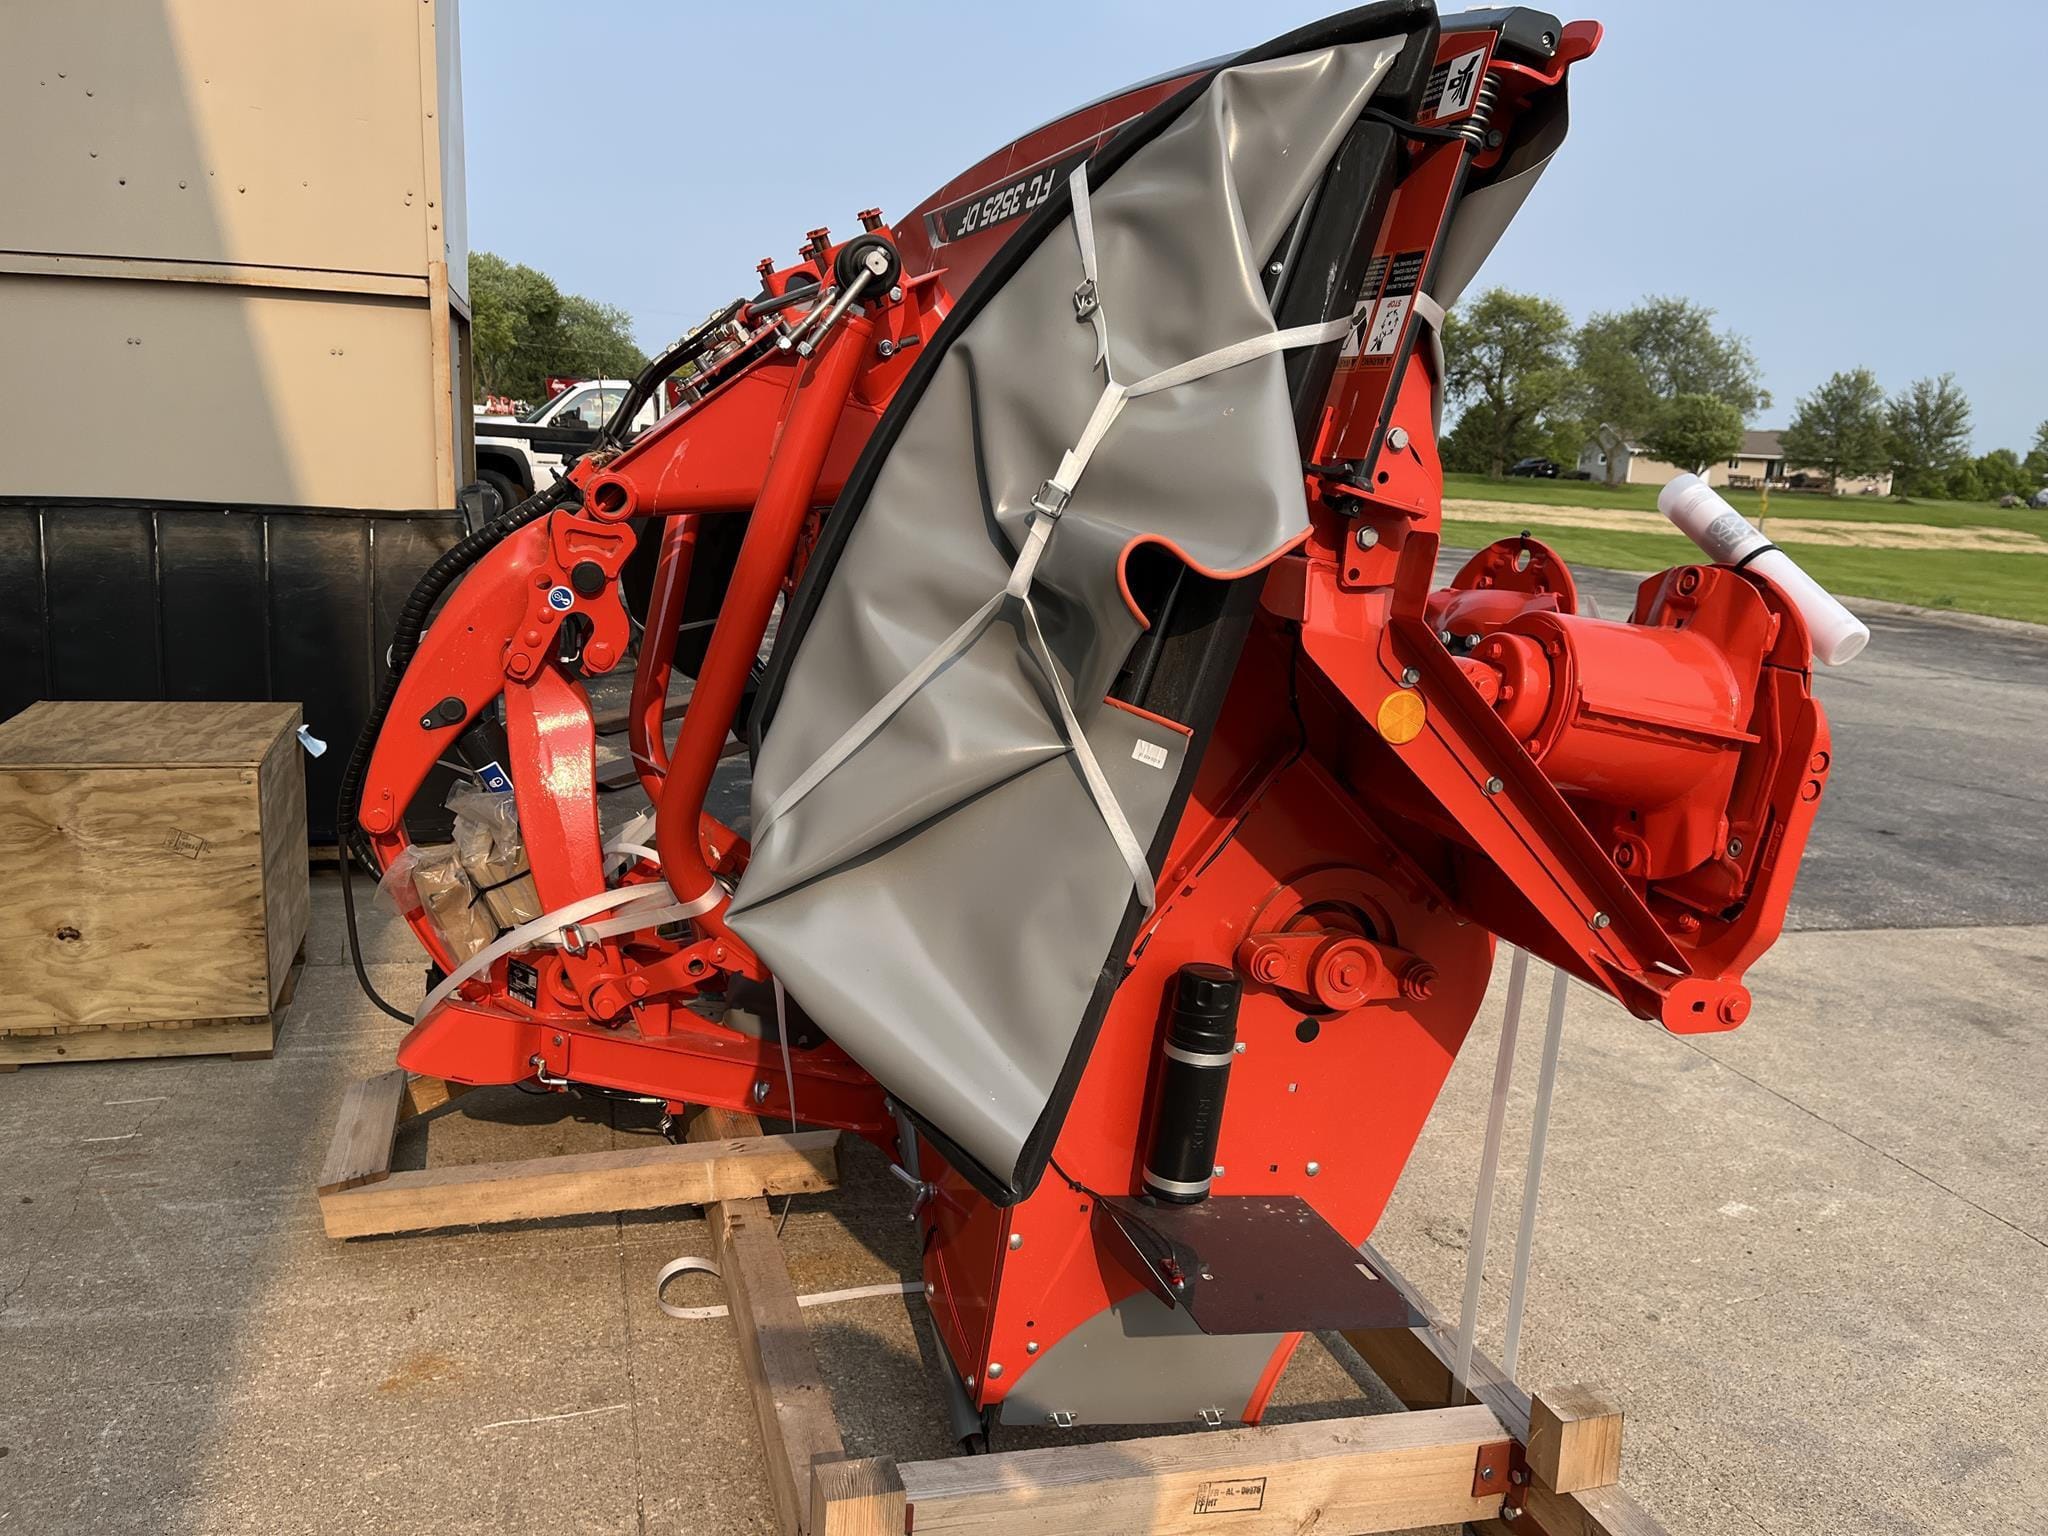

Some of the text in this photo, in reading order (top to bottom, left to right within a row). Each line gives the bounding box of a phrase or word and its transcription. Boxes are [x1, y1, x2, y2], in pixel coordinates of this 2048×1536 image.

[957, 168, 1056, 236] FC 3525 DF
[1387, 299, 1402, 309] STOP
